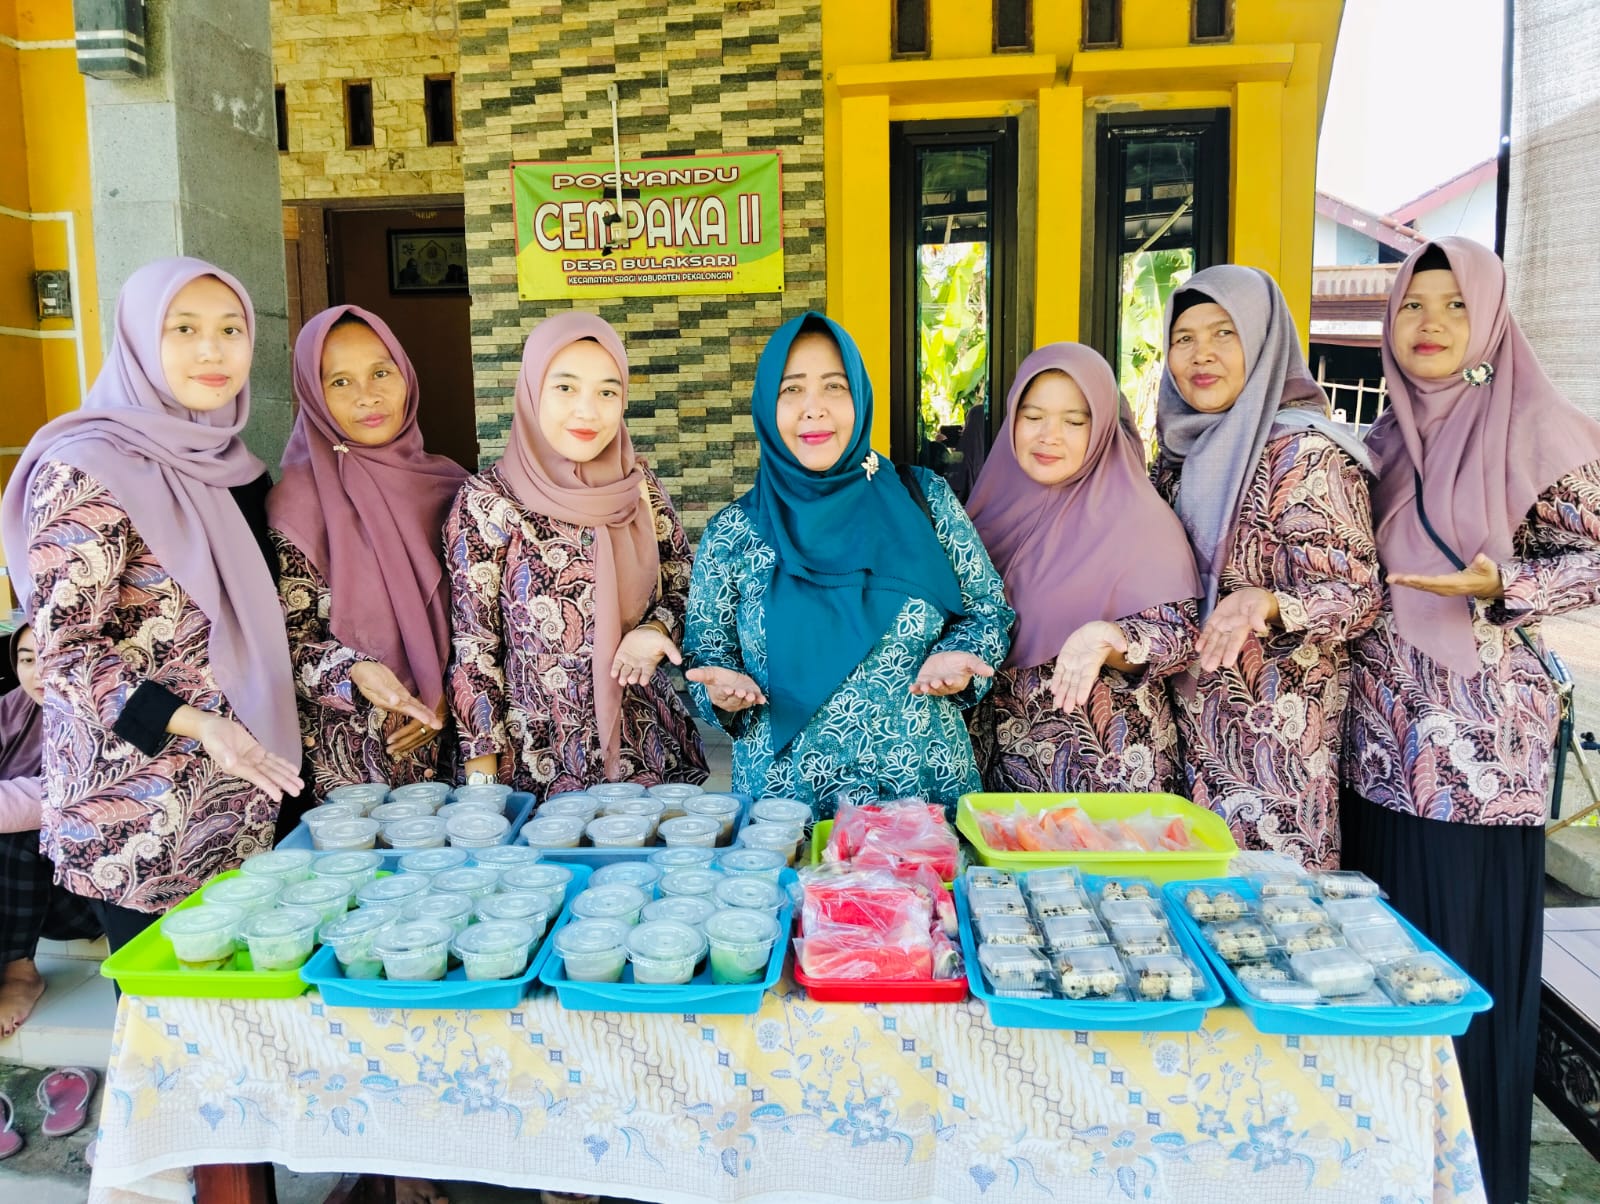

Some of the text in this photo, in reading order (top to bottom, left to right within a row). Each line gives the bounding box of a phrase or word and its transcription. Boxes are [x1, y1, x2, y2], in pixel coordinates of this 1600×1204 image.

[553, 167, 738, 189] POSYANDU
[534, 194, 761, 250] CEMPAKA II
[563, 255, 736, 271] DESA BULAKSARI
[568, 276, 613, 285] KECAMATAN
[638, 273, 681, 282] KABUPATEN
[682, 271, 732, 281] PEKALONGAN
